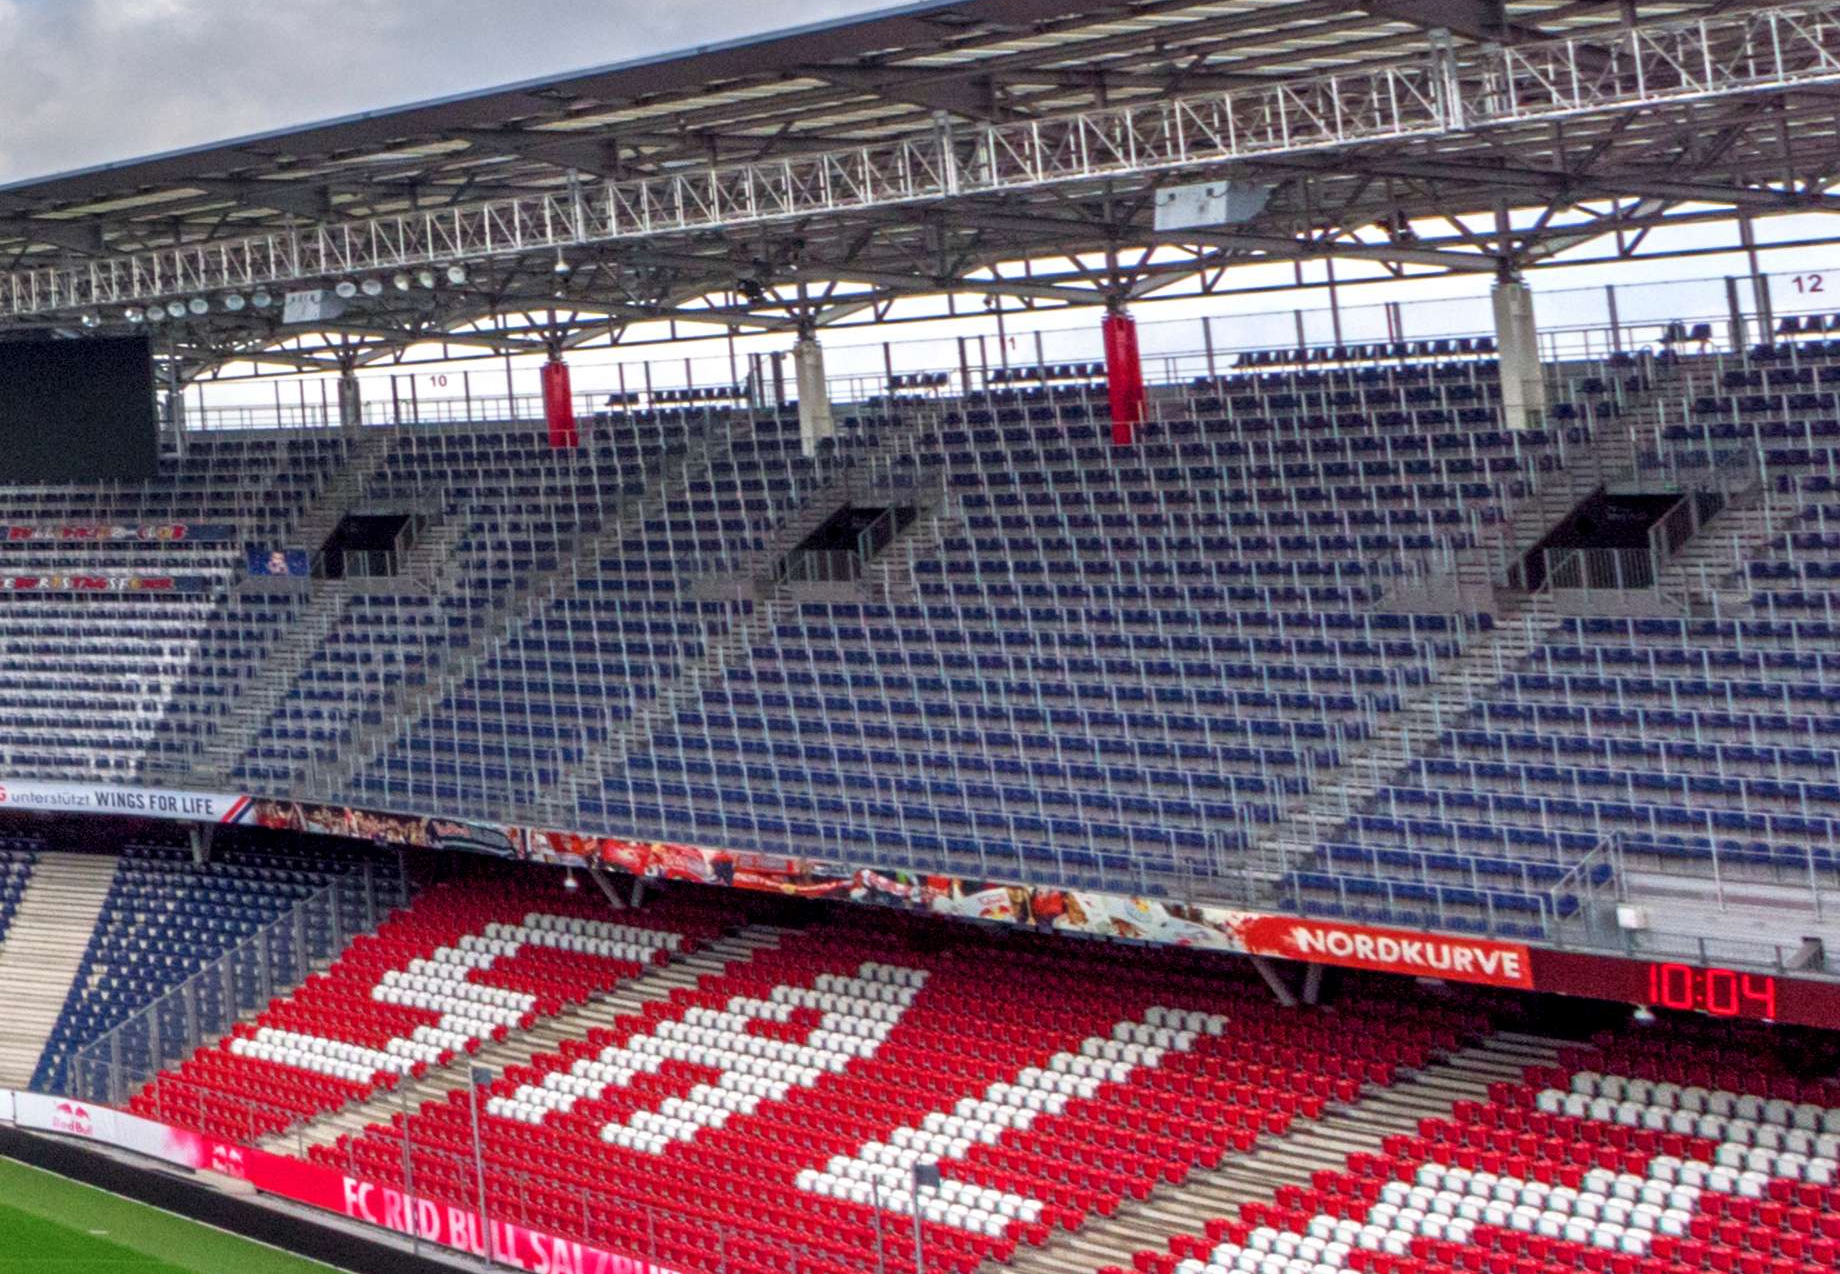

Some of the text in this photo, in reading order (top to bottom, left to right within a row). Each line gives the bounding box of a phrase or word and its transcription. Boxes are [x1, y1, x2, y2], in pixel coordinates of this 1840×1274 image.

[1792, 273, 1825, 294] 12
[429, 374, 448, 388] 10
[11, 788, 90, 807] unterstützt
[94, 790, 145, 810] WINGS
[149, 793, 178, 813] FOR
[182, 796, 215, 816] LIFE
[1293, 926, 1523, 980] NORDKURVE
[1648, 961, 1777, 1020] 10:04
[343, 1176, 377, 1223] FC
[447, 1206, 526, 1268] BULL
